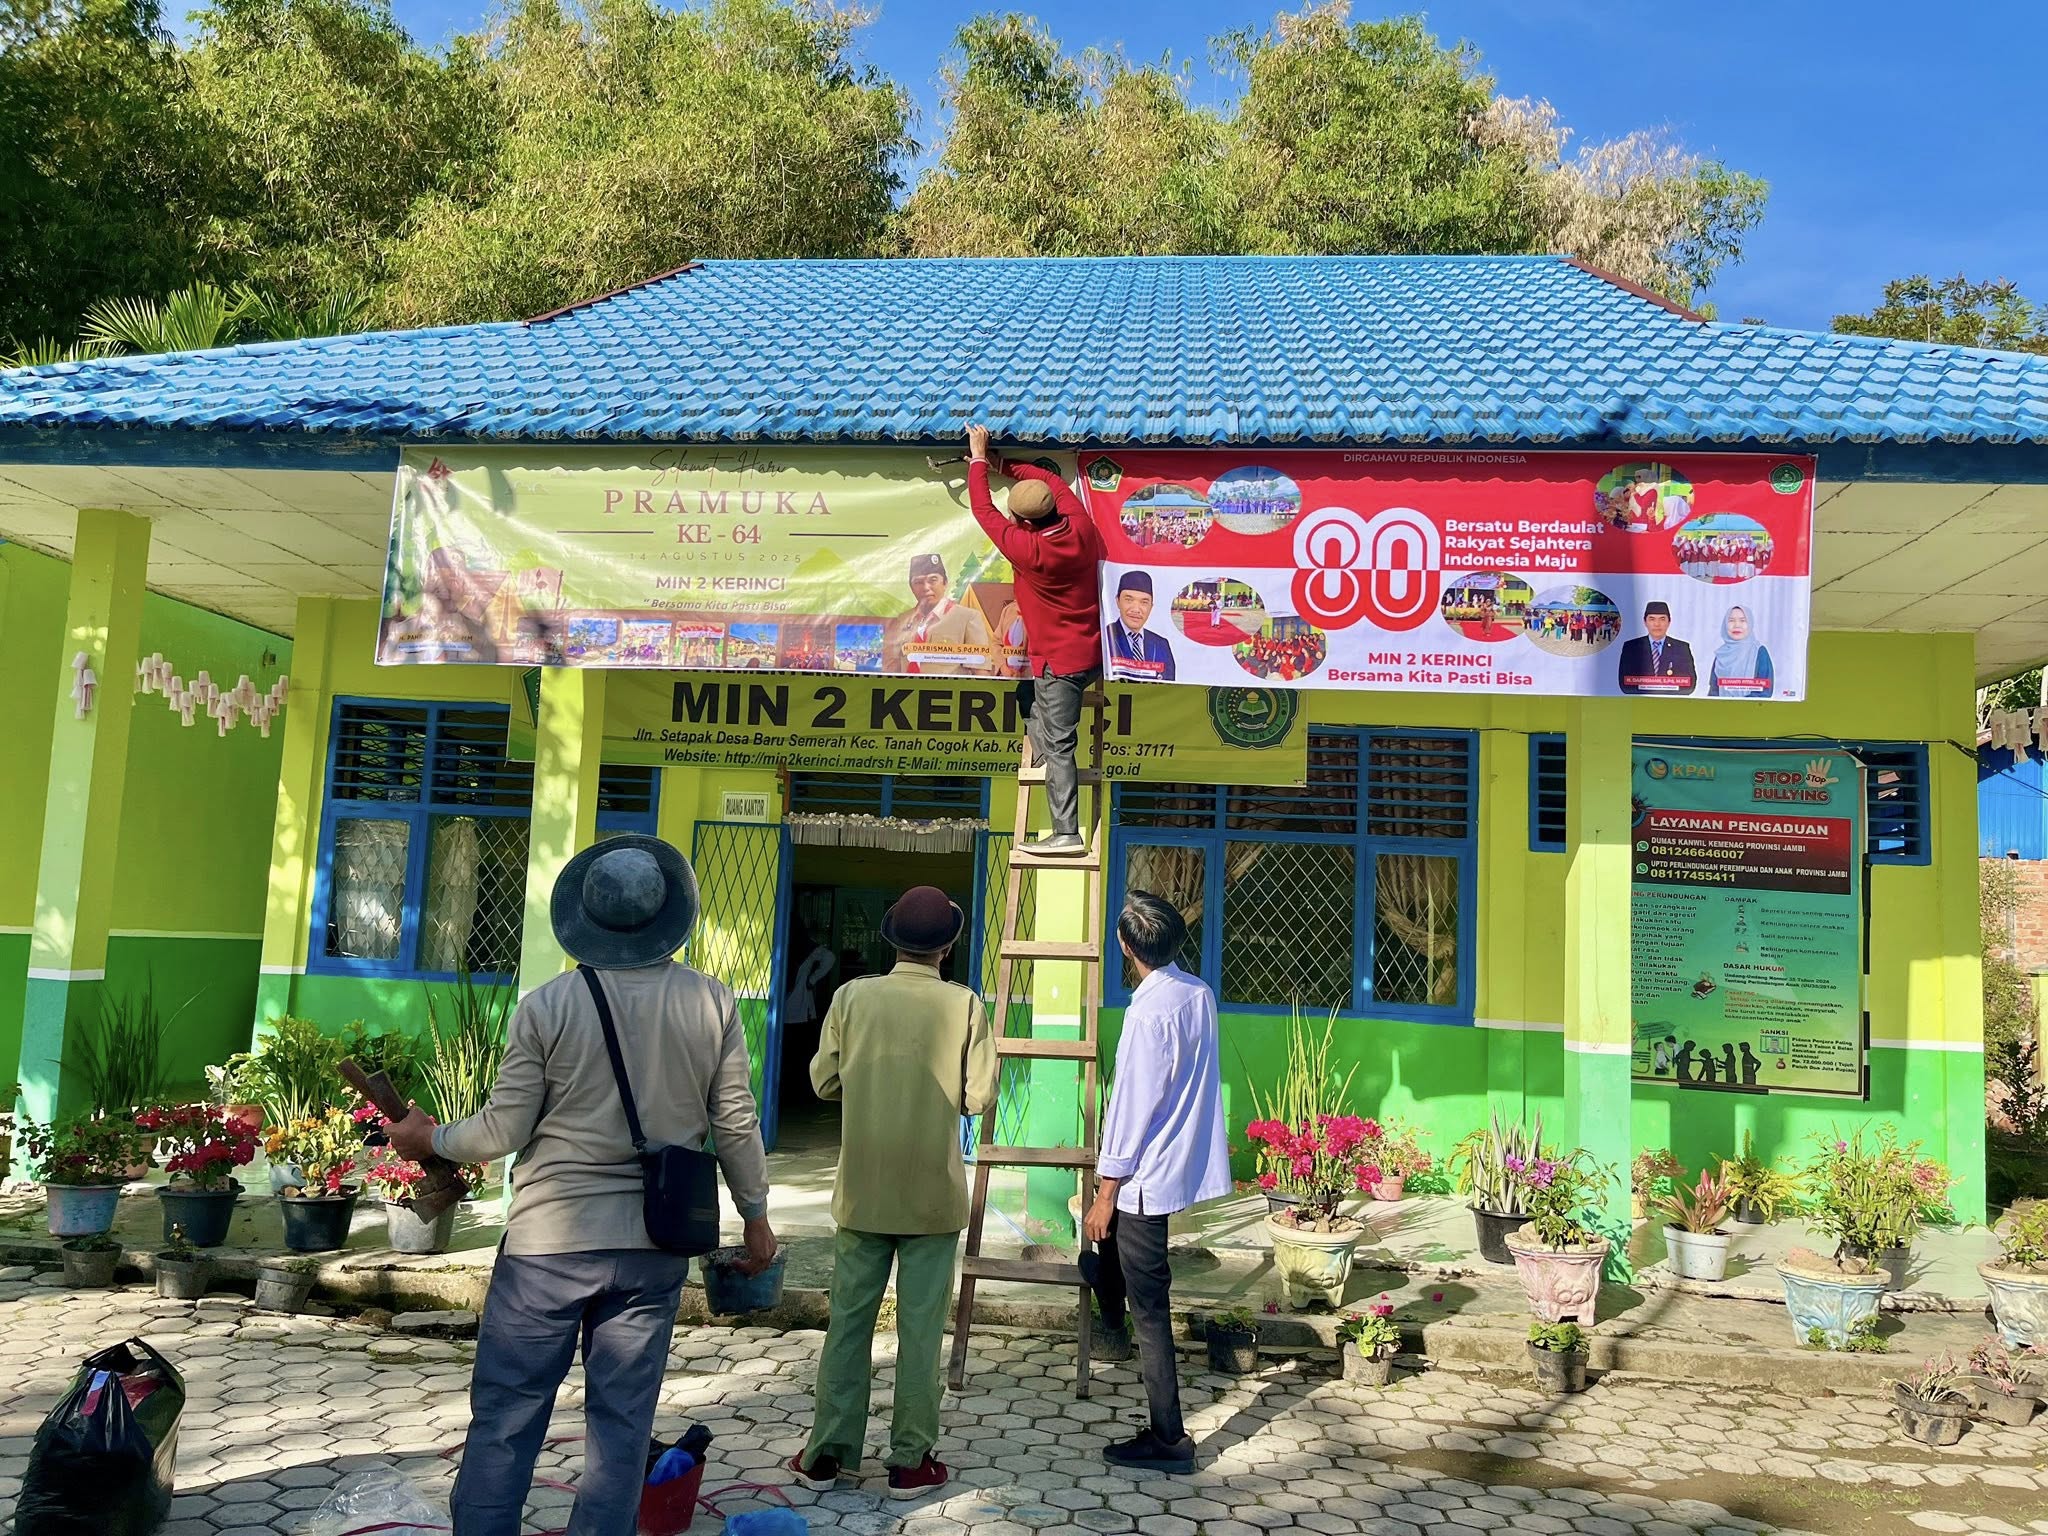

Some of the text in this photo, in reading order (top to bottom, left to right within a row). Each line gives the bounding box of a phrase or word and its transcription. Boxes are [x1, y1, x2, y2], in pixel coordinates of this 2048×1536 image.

[1343, 454, 1528, 464] DIRGAHAYU REPUBLIK INDONESIA
[603, 489, 832, 515] PRAMUKA
[677, 524, 711, 544] KE
[732, 524, 762, 544] 64
[1445, 519, 1604, 535] Bersatu Berdaulat
[1445, 536, 1593, 554] Rakyat Sejahtera
[630, 552, 801, 562] 14 AGUSTUS 2025
[1444, 554, 1578, 572] Indonesia Maju
[1291, 507, 1441, 632] 80
[656, 577, 786, 591] MIN 2 KERINCI
[705, 600, 728, 610] Kita
[732, 600, 760, 610] Pasti
[1368, 653, 1492, 668] MIN 2 KERINCI
[1328, 669, 1533, 686] Bersama Kita Pasti Bisa
[672, 682, 790, 727] MIN
[811, 686, 848, 729] 2
[632, 728, 655, 742] Jln.
[660, 728, 712, 746] Setapak
[716, 731, 749, 745] Desa
[753, 732, 784, 746] Baru
[788, 734, 846, 748] Semerah
[850, 736, 878, 750] Kec.
[884, 737, 922, 750] Tanah
[926, 738, 969, 754] Cogok
[972, 739, 1002, 753] Kab.
[1135, 744, 1175, 758] 37171
[664, 748, 720, 763] Website:
[896, 756, 942, 771] E-Mail:
[1672, 764, 1716, 778] KPAI
[1754, 771, 1826, 785] STOP STOP
[1754, 788, 1829, 802] BULLYING
[726, 798, 764, 816] RUANG KANTOR
[1650, 816, 1828, 836] LAYANAN PENGADUAN
[1651, 837, 1806, 852] DUMAS KANWIL KEMENAG PROVINSI JAMBI
[1651, 846, 1744, 860] 081246646007
[1650, 860, 1668, 868] UPTD
[1670, 862, 1718, 871] PERLINDUNGAN
[1720, 864, 1758, 873] PEREMPUAN
[1760, 866, 1774, 874] DAN
[1796, 868, 1826, 877] PROVINSI
[1828, 870, 1848, 878] JAMBI
[1650, 868, 1736, 882] 08117455411
[1646, 892, 1706, 900] PERUNDUNGAN
[1724, 896, 1758, 904] DAMPAK
[1724, 962, 1785, 972] DASAR HUKUM
